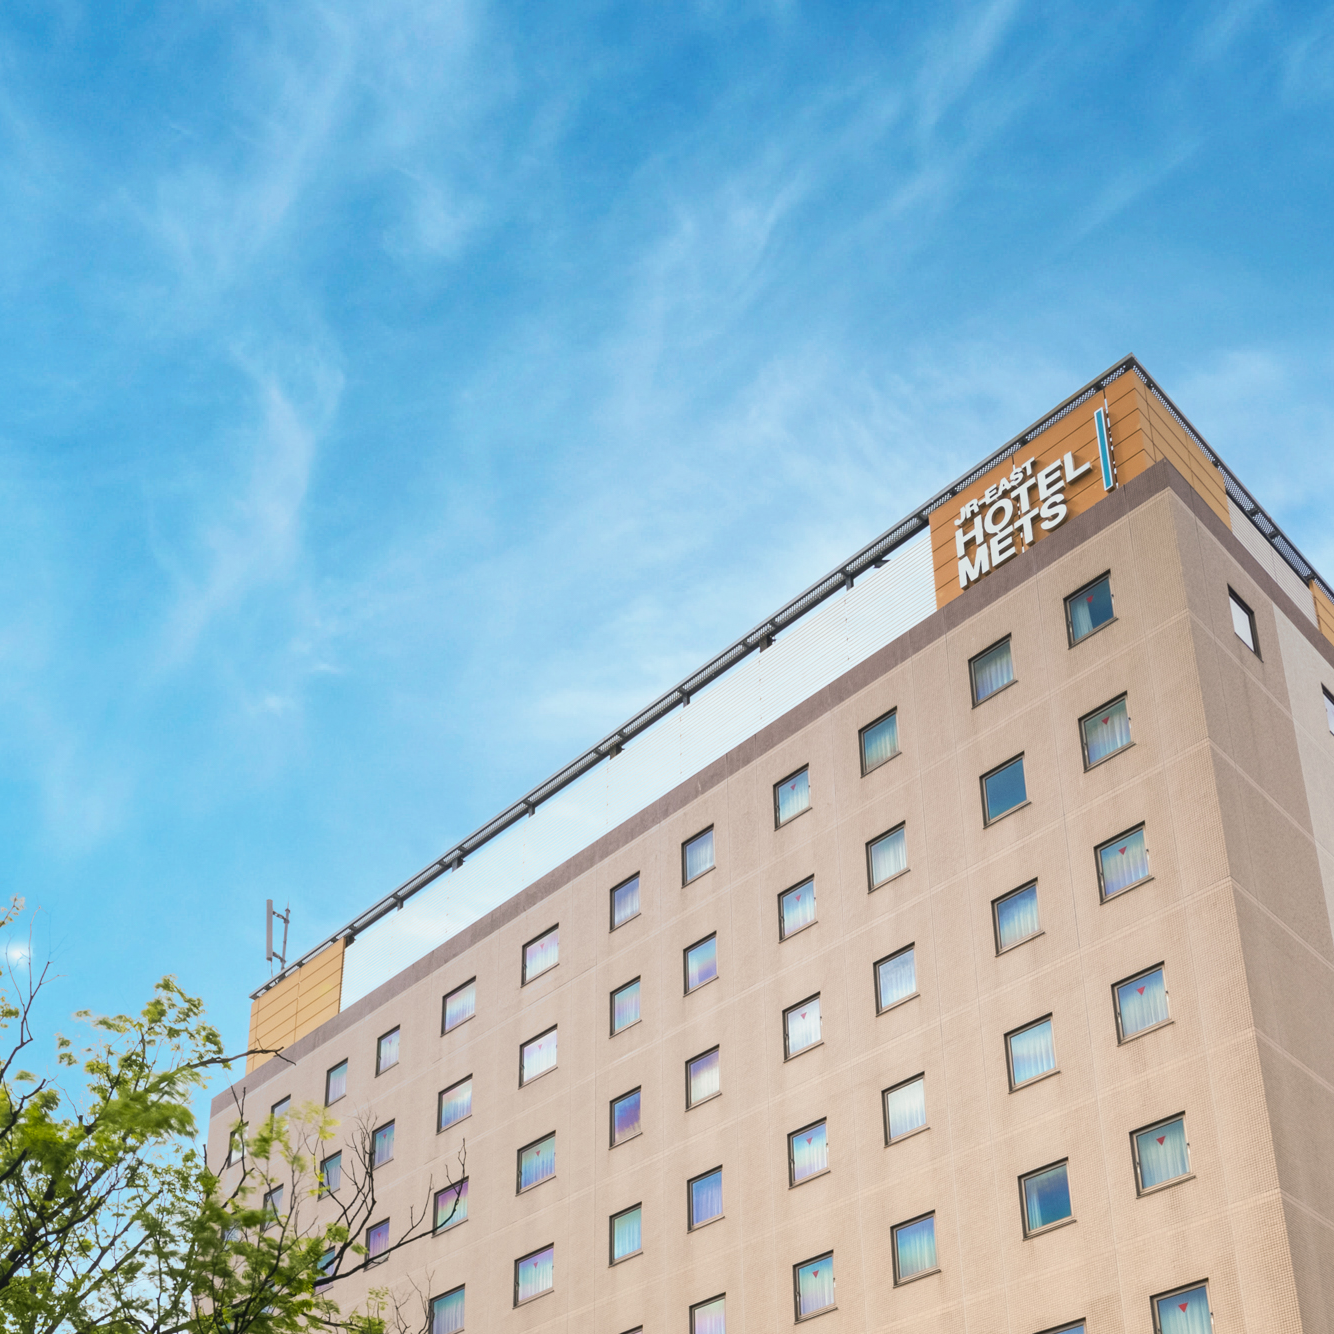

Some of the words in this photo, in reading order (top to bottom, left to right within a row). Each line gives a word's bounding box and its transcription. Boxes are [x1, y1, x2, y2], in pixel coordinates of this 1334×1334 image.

[954, 456, 1035, 526] JR-EAST
[955, 451, 1091, 558] HOTEL
[958, 493, 1067, 589] METS
